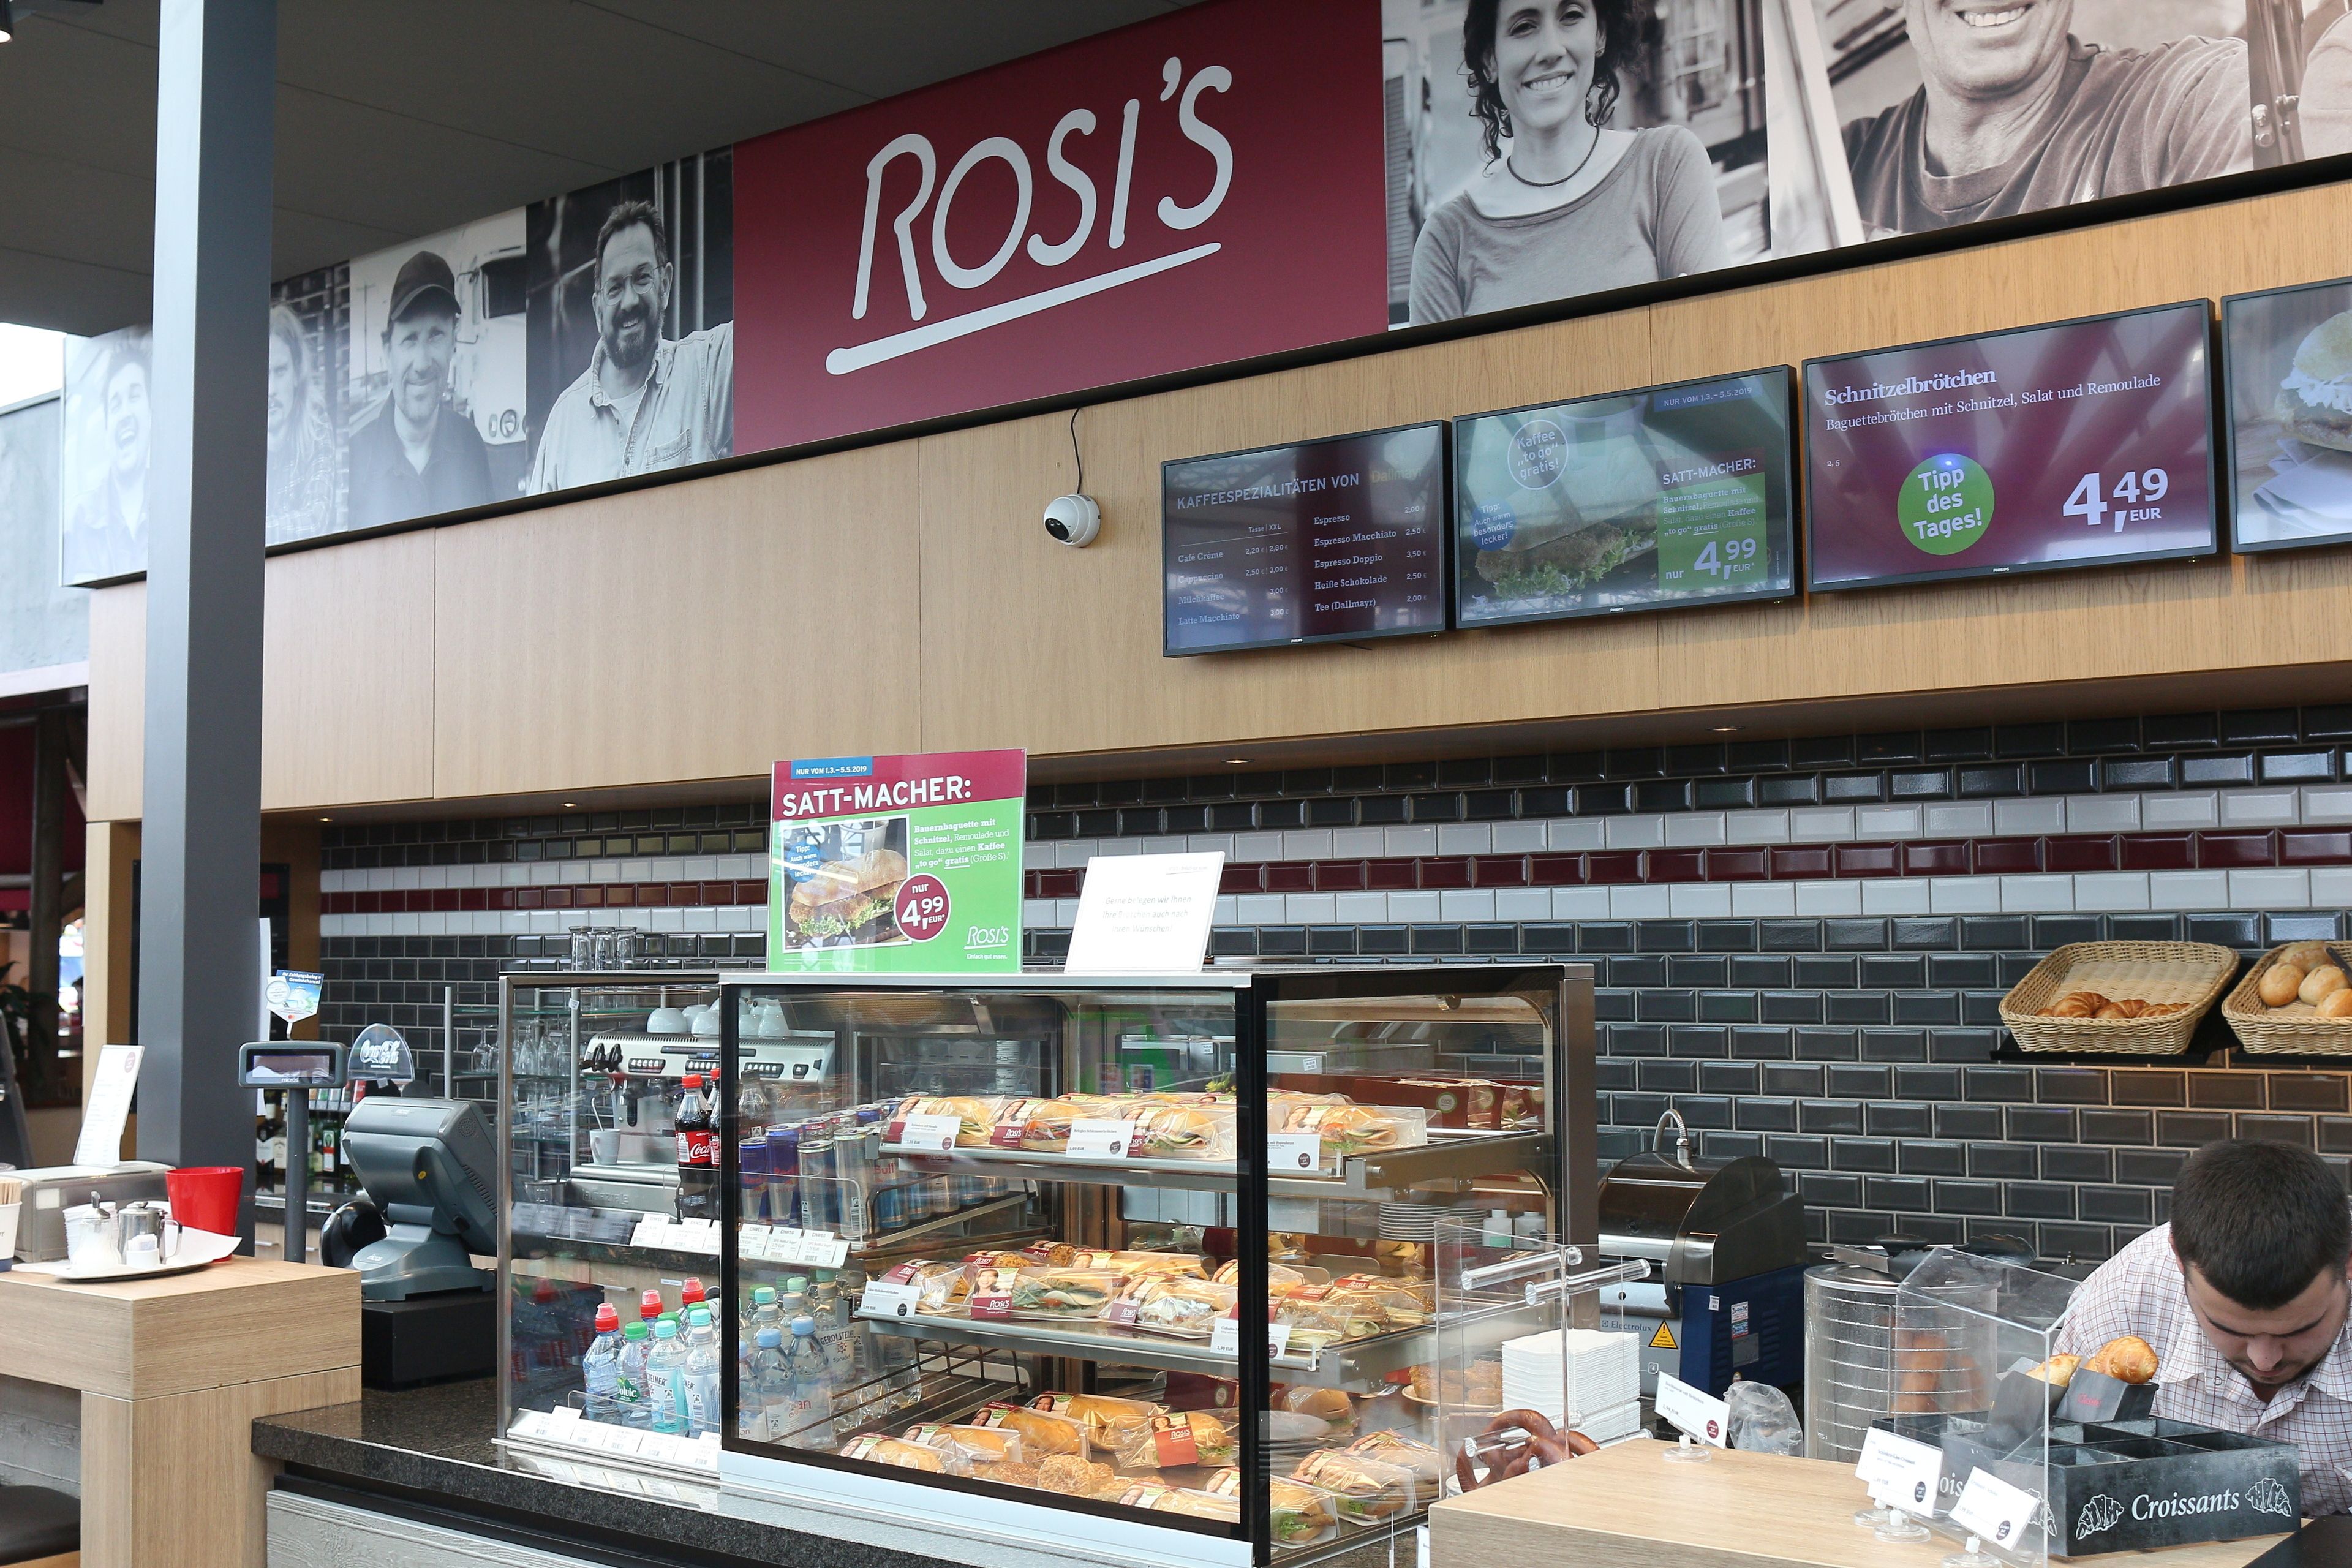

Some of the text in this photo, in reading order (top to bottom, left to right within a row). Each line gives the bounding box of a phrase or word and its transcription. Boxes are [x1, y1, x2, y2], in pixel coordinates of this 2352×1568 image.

[852, 56, 1233, 321] ROSI'S
[1824, 368, 1997, 407] Schnitzelbrötchen
[1664, 398, 1679, 407] NUR
[1826, 374, 2161, 431] Baguettebrötchen mit Schnitzel, Salat und Remoulade
[1517, 430, 1556, 450] Kaffee
[1520, 458, 1559, 480] gratis!
[1662, 458, 1757, 485] SATT-MACHER:
[1918, 466, 1965, 492] Tipp
[1177, 478, 1326, 510] KAFFEESPEZIALITÄTEN
[1331, 473, 1359, 489] VON
[1663, 489, 1729, 503] Bauernbaguette
[2062, 467, 2169, 533] 4,49 EUR
[1481, 502, 1501, 514] Tipp:
[1664, 503, 1702, 514] Schnitzel,
[1926, 492, 1963, 514] des
[1313, 505, 1420, 526] Espresso 2,00
[1474, 512, 1511, 526] Auch warm
[1728, 508, 1756, 517] Kaffee
[1474, 519, 1513, 537] besonders
[1694, 522, 1718, 533] gratis
[1913, 508, 1983, 540] Tages!
[1314, 527, 1421, 548] Espresso Macchiato 2,50
[1481, 531, 1508, 545] lecker!
[1178, 544, 1284, 564] Café Crème 2,20 2,80
[1314, 549, 1422, 570] Espresso Doppio 3,50
[1694, 538, 1757, 579] 4,99
[1178, 565, 1284, 586] Cappuccino 2,50 3,00
[1314, 571, 1422, 590] Heiße Schokolade 2,50
[1666, 570, 1684, 579] nur
[1178, 587, 1284, 605] Milchkaffee 3,00
[1315, 594, 1422, 613] Tee (Dallmayr) 2,00
[1178, 608, 1284, 625] Latte Macchiato 3,00
[782, 775, 972, 817] SATT-MACHER:
[914, 818, 996, 833] Bauernbaguette mit
[914, 829, 1010, 845] Schnitzel, Remoulade und
[944, 856, 970, 867] gratis
[911, 882, 929, 894] nur
[1170, 895, 1191, 903] Ihnen
[901, 895, 944, 930] 4,99
[1170, 909, 1188, 918] nach
[967, 925, 1009, 946] ROSI'S
[1006, 1129, 1022, 1137] ROSI'S
[989, 1299, 1010, 1309] ROSI'S
[1120, 1306, 1136, 1316] ROSI'S
[1611, 1321, 1653, 1332] Electrolux
[1171, 1428, 1191, 1439] ROSI'S
[2131, 1486, 2240, 1523] Croissants
